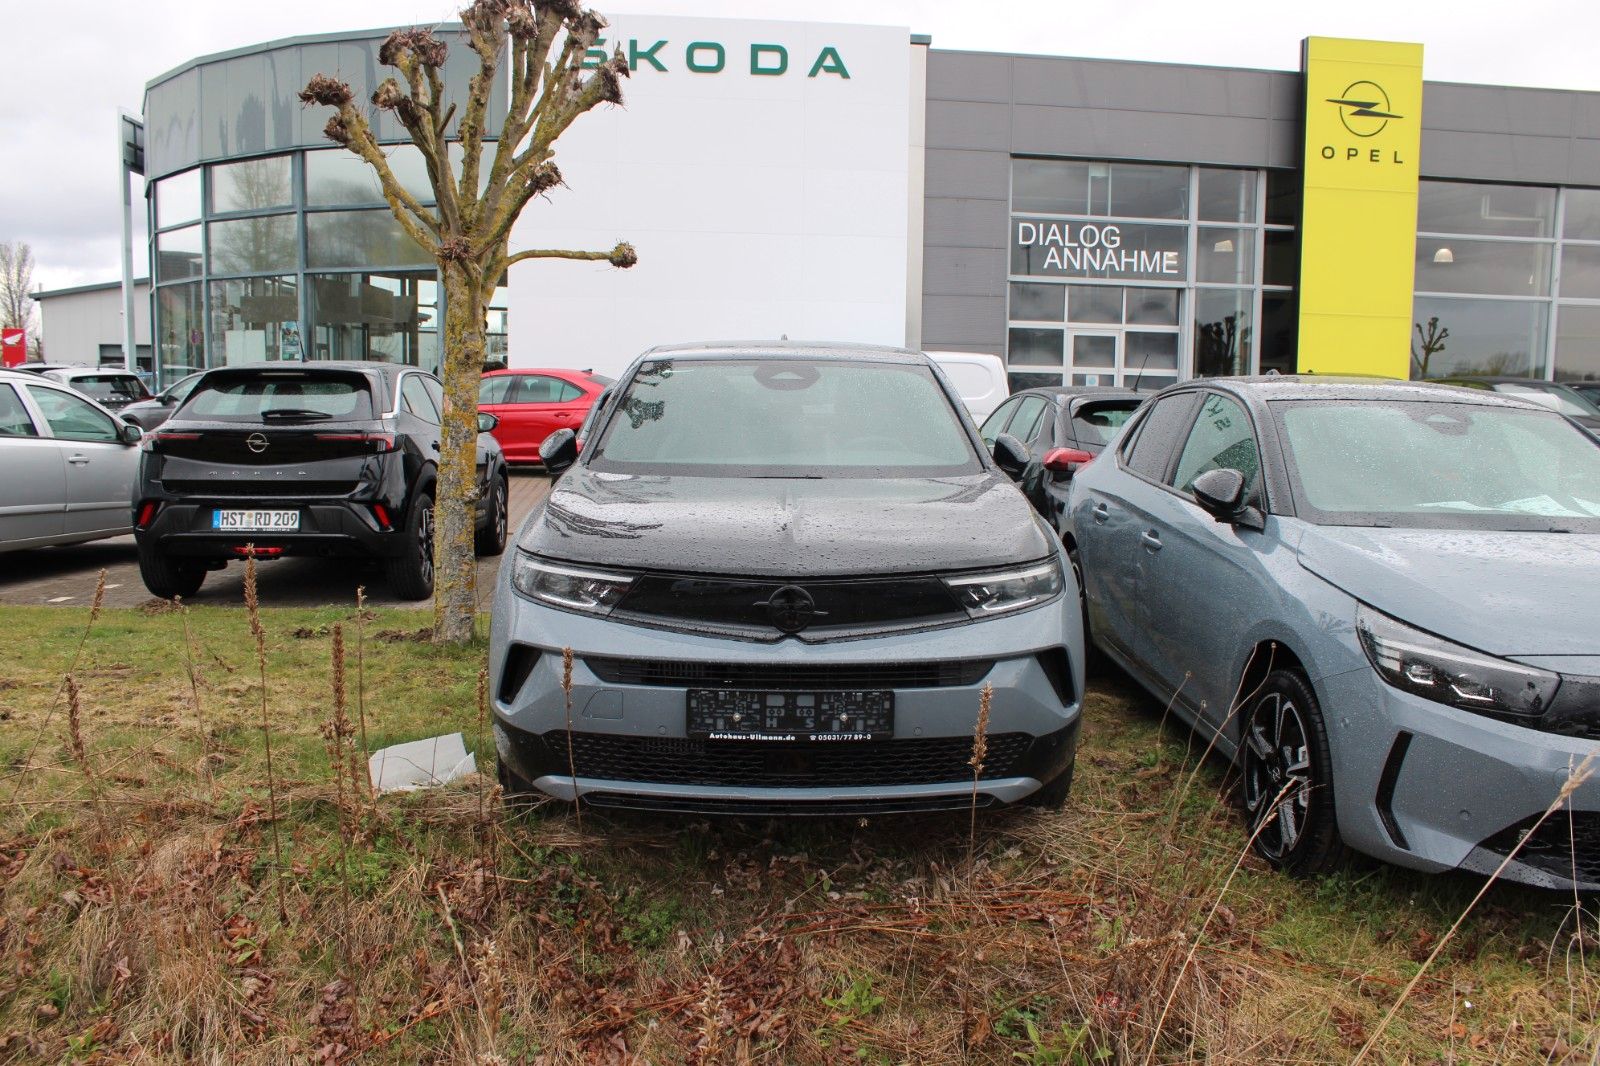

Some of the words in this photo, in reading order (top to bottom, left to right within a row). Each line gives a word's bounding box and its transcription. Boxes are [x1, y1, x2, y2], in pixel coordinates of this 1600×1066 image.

[1321, 145, 1403, 164] OPEL
[1018, 222, 1121, 248] DIALOG
[1043, 247, 1179, 274] ANNAHME
[221, 512, 245, 526] HST
[254, 512, 271, 526] RD
[274, 512, 298, 526] 209
